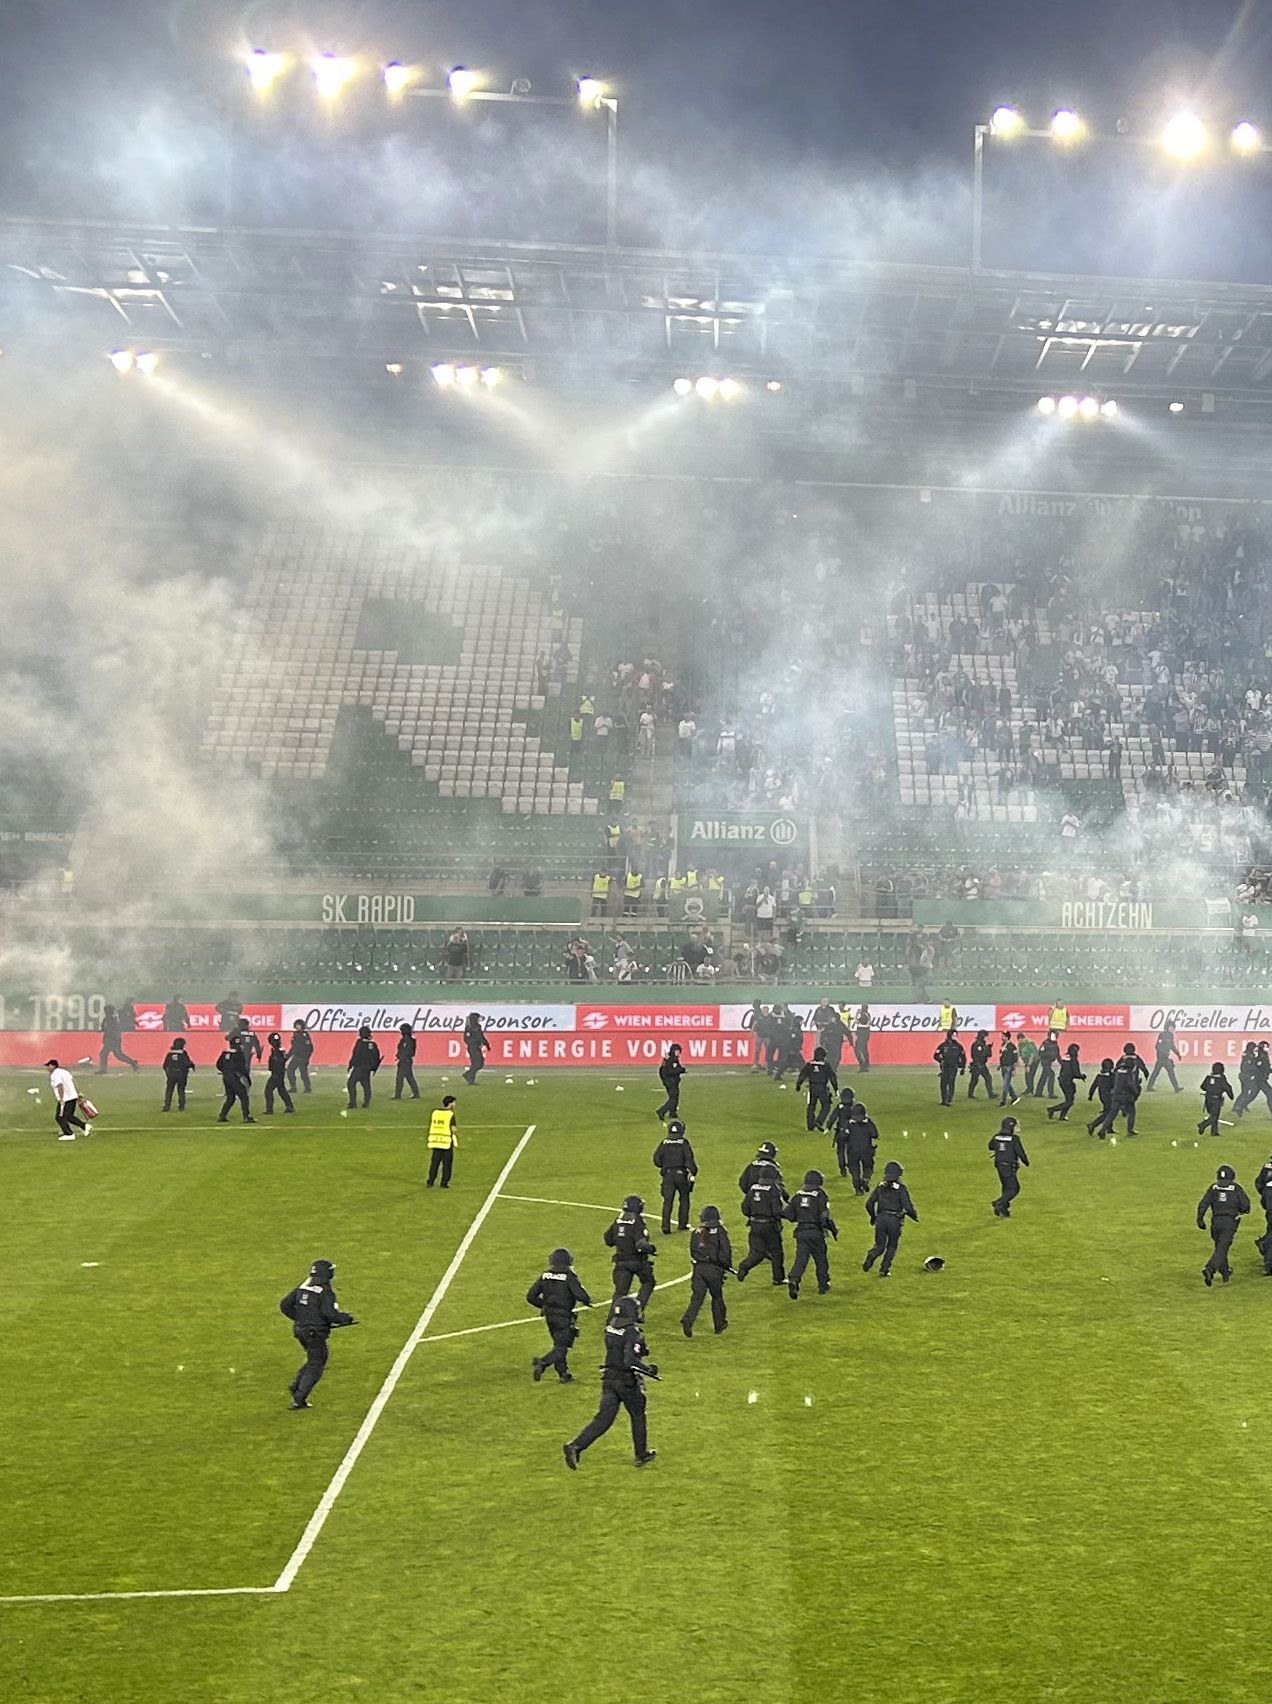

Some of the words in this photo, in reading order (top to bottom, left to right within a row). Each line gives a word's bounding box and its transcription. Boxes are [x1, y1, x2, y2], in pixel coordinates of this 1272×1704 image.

[690, 821, 766, 840] Allianz
[322, 895, 347, 922] SK
[358, 895, 415, 923] RAPID
[1062, 902, 1153, 929] ACHTZEHN
[306, 1008, 404, 1030] Offizieller
[614, 1015, 651, 1027] WIEN
[654, 1015, 714, 1027] ENERGIE
[1069, 1015, 1124, 1026] ENERGIE
[1150, 1008, 1239, 1030] Offizieller
[503, 1039, 613, 1058] ENERGIE
[627, 1040, 674, 1058] VON
[688, 1039, 750, 1058] WIEN
[1180, 1040, 1210, 1057] DIE
